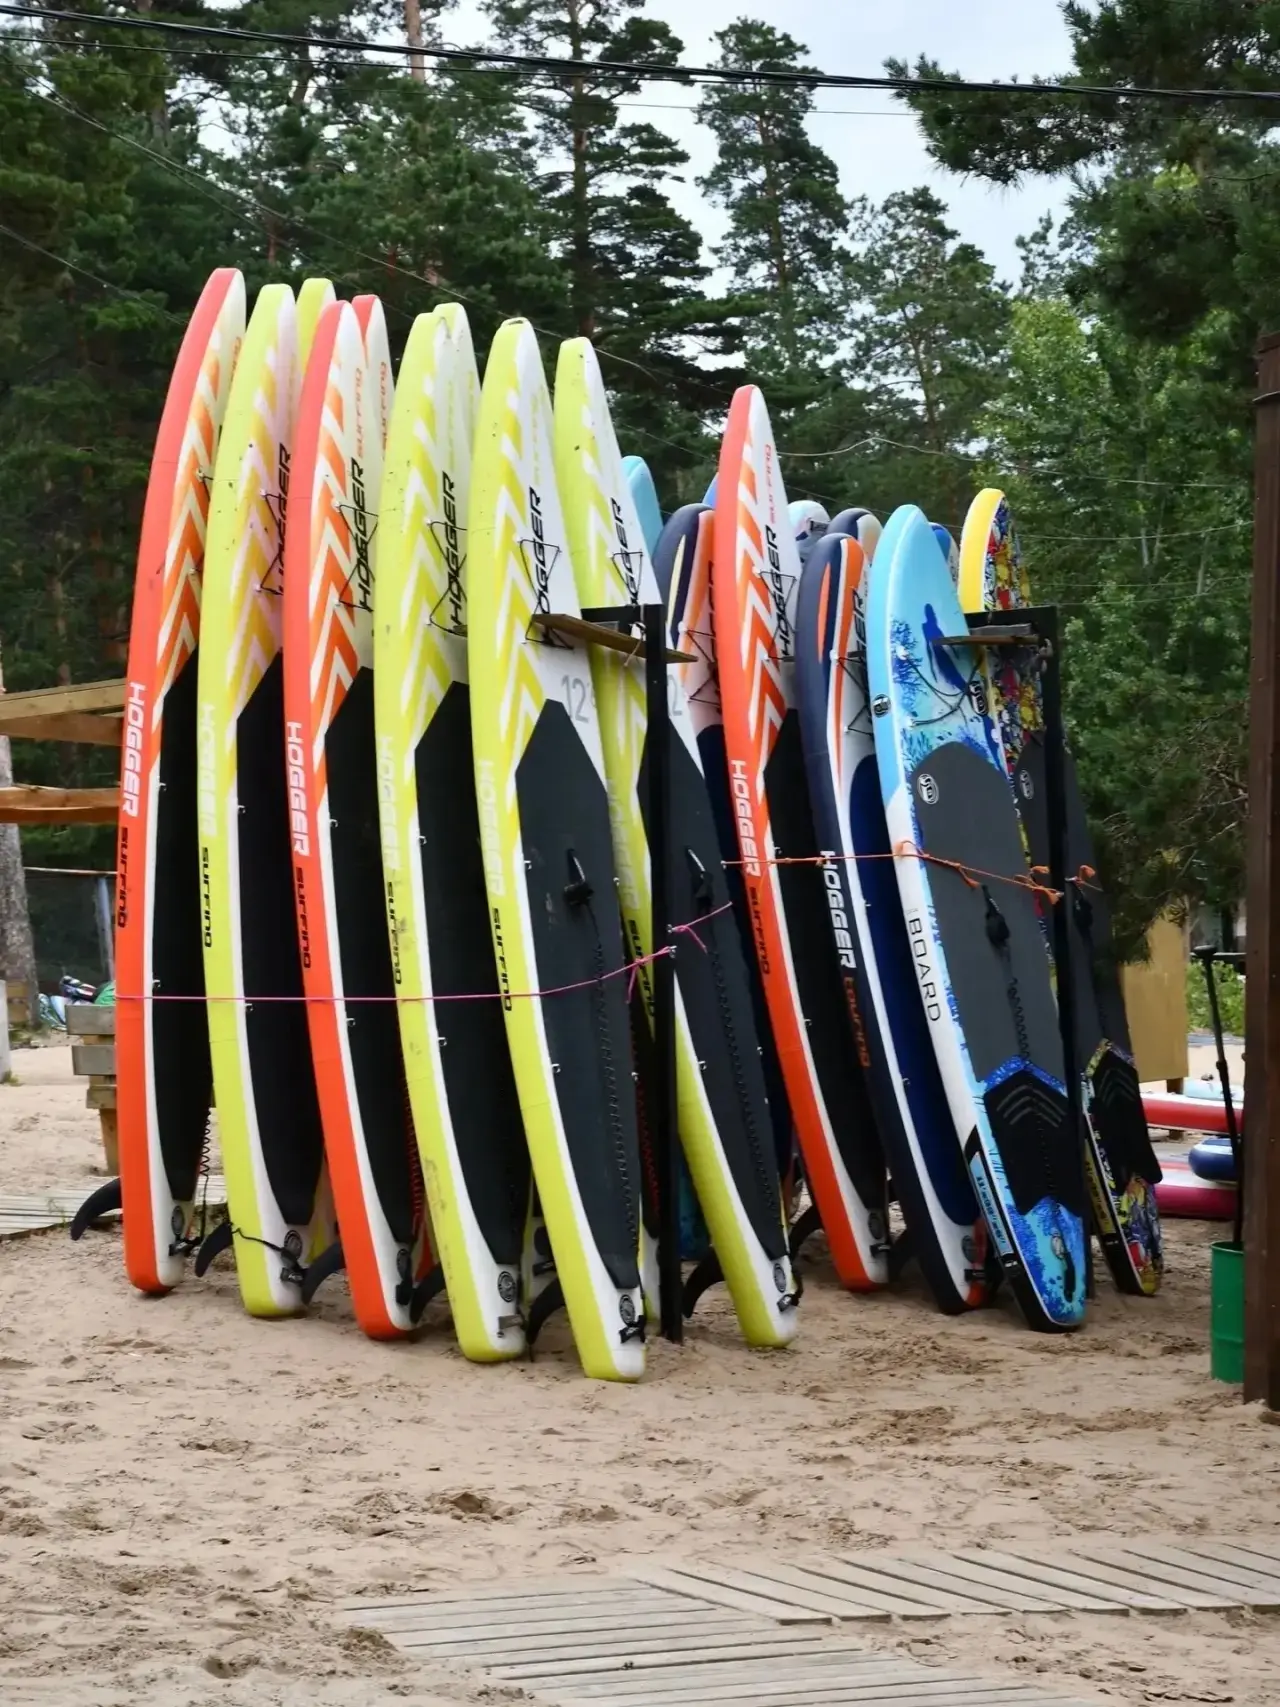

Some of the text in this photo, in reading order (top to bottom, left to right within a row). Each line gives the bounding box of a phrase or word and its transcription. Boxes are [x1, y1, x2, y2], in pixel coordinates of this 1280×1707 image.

[529, 485, 550, 614] OGGER
[123, 681, 147, 818] HOGGER
[561, 674, 589, 723] 12
[200, 703, 218, 837] HOGGER
[287, 721, 310, 857] HOGGER
[381, 735, 401, 871] HOGGER
[479, 759, 506, 897] HOGGER
[730, 760, 761, 877] HOGGER
[820, 850, 857, 969] HOGGER
[908, 917, 942, 1023] BOARD
